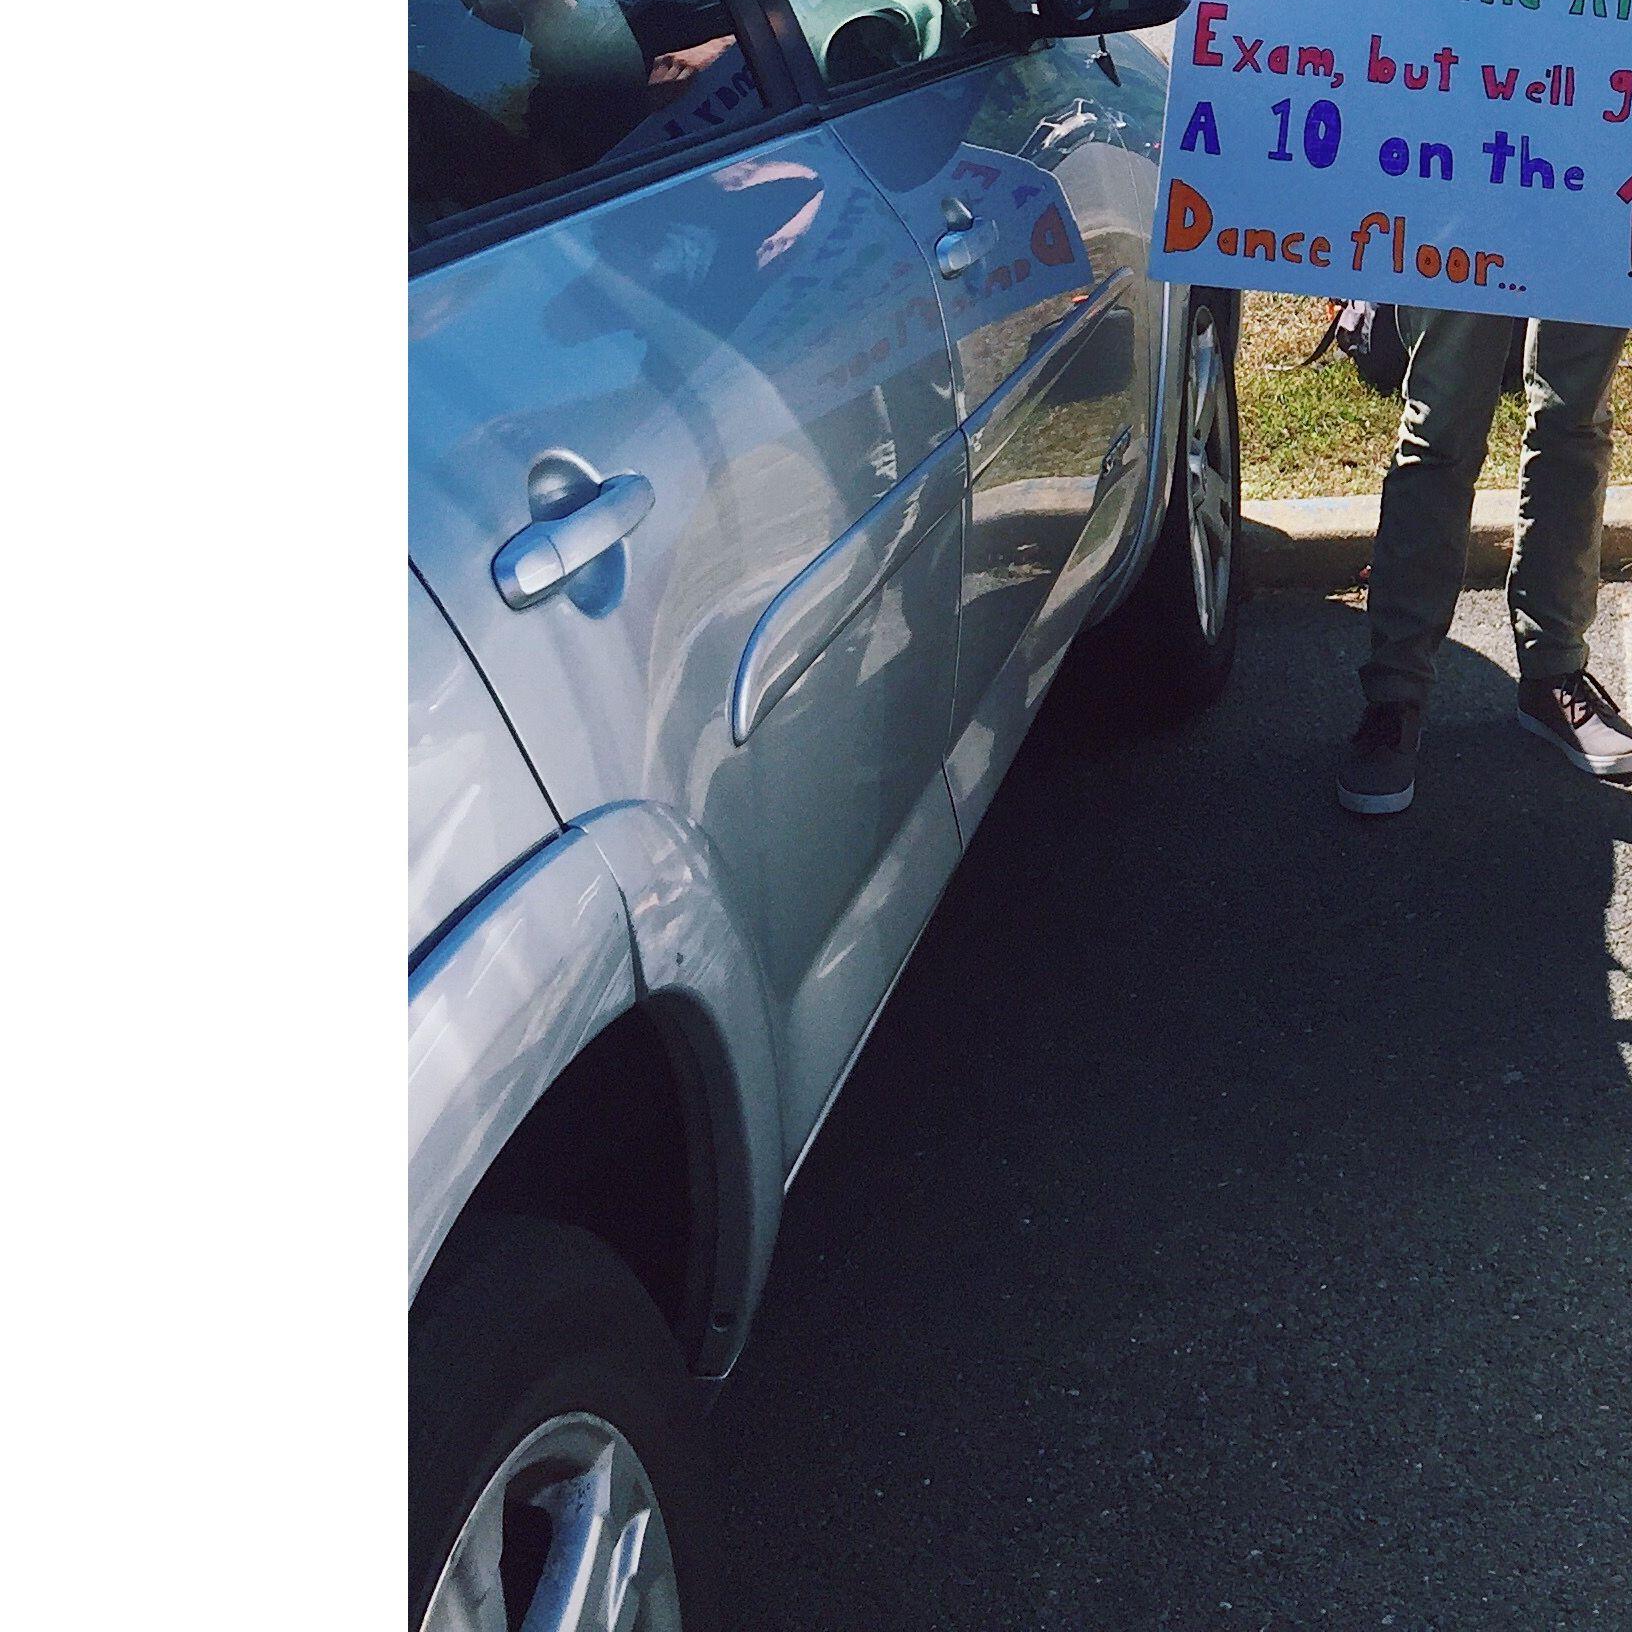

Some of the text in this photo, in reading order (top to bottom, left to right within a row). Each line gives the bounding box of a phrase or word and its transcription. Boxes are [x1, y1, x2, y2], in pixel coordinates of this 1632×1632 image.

[1192, 2, 1343, 89] Exam,
[1367, 35, 1459, 92] but
[1180, 98, 1585, 191] A 10 on the
[1163, 178, 1332, 267] Dance
